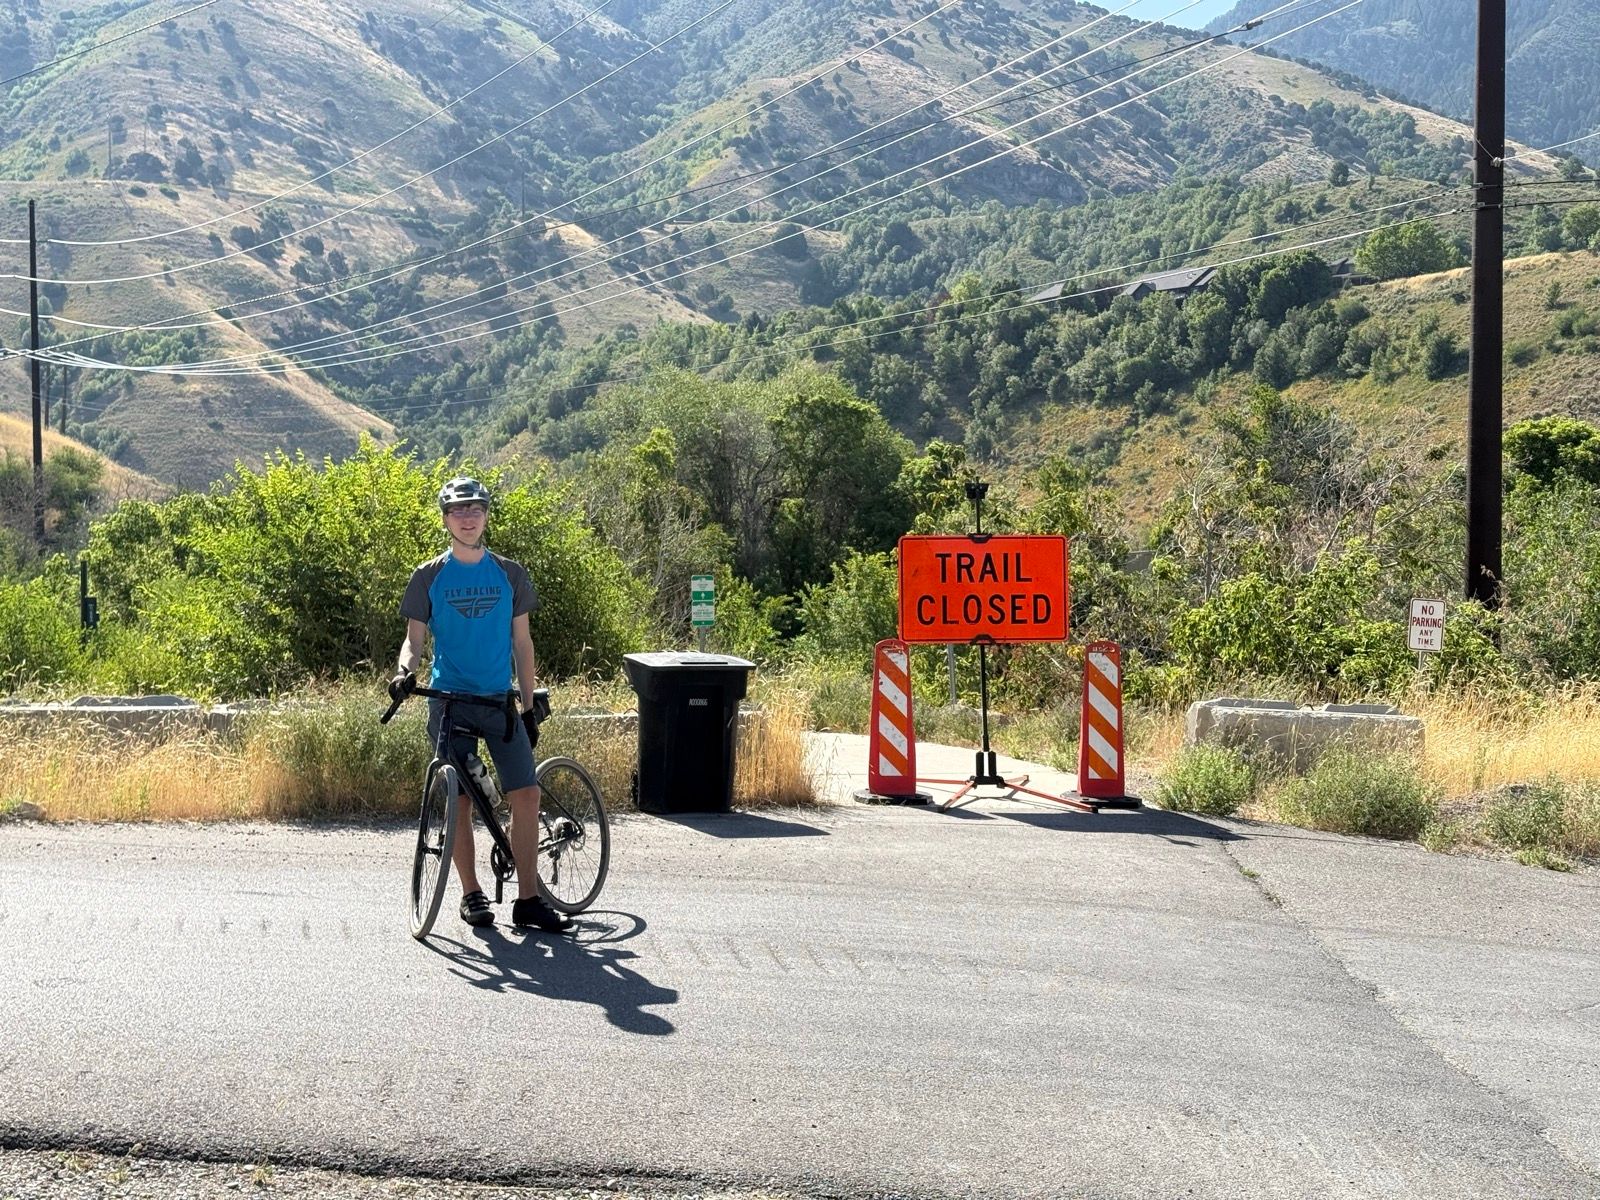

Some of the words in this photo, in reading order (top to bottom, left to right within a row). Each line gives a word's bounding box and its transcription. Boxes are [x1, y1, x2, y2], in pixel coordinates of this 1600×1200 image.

[935, 553, 1032, 583] TRAIL
[444, 588, 461, 598] FLY
[465, 585, 502, 596] RACING
[917, 594, 1052, 625] CLOSED
[1421, 605, 1435, 615] NO
[1412, 617, 1442, 628] PARKING
[1418, 637, 1434, 645] TIME
